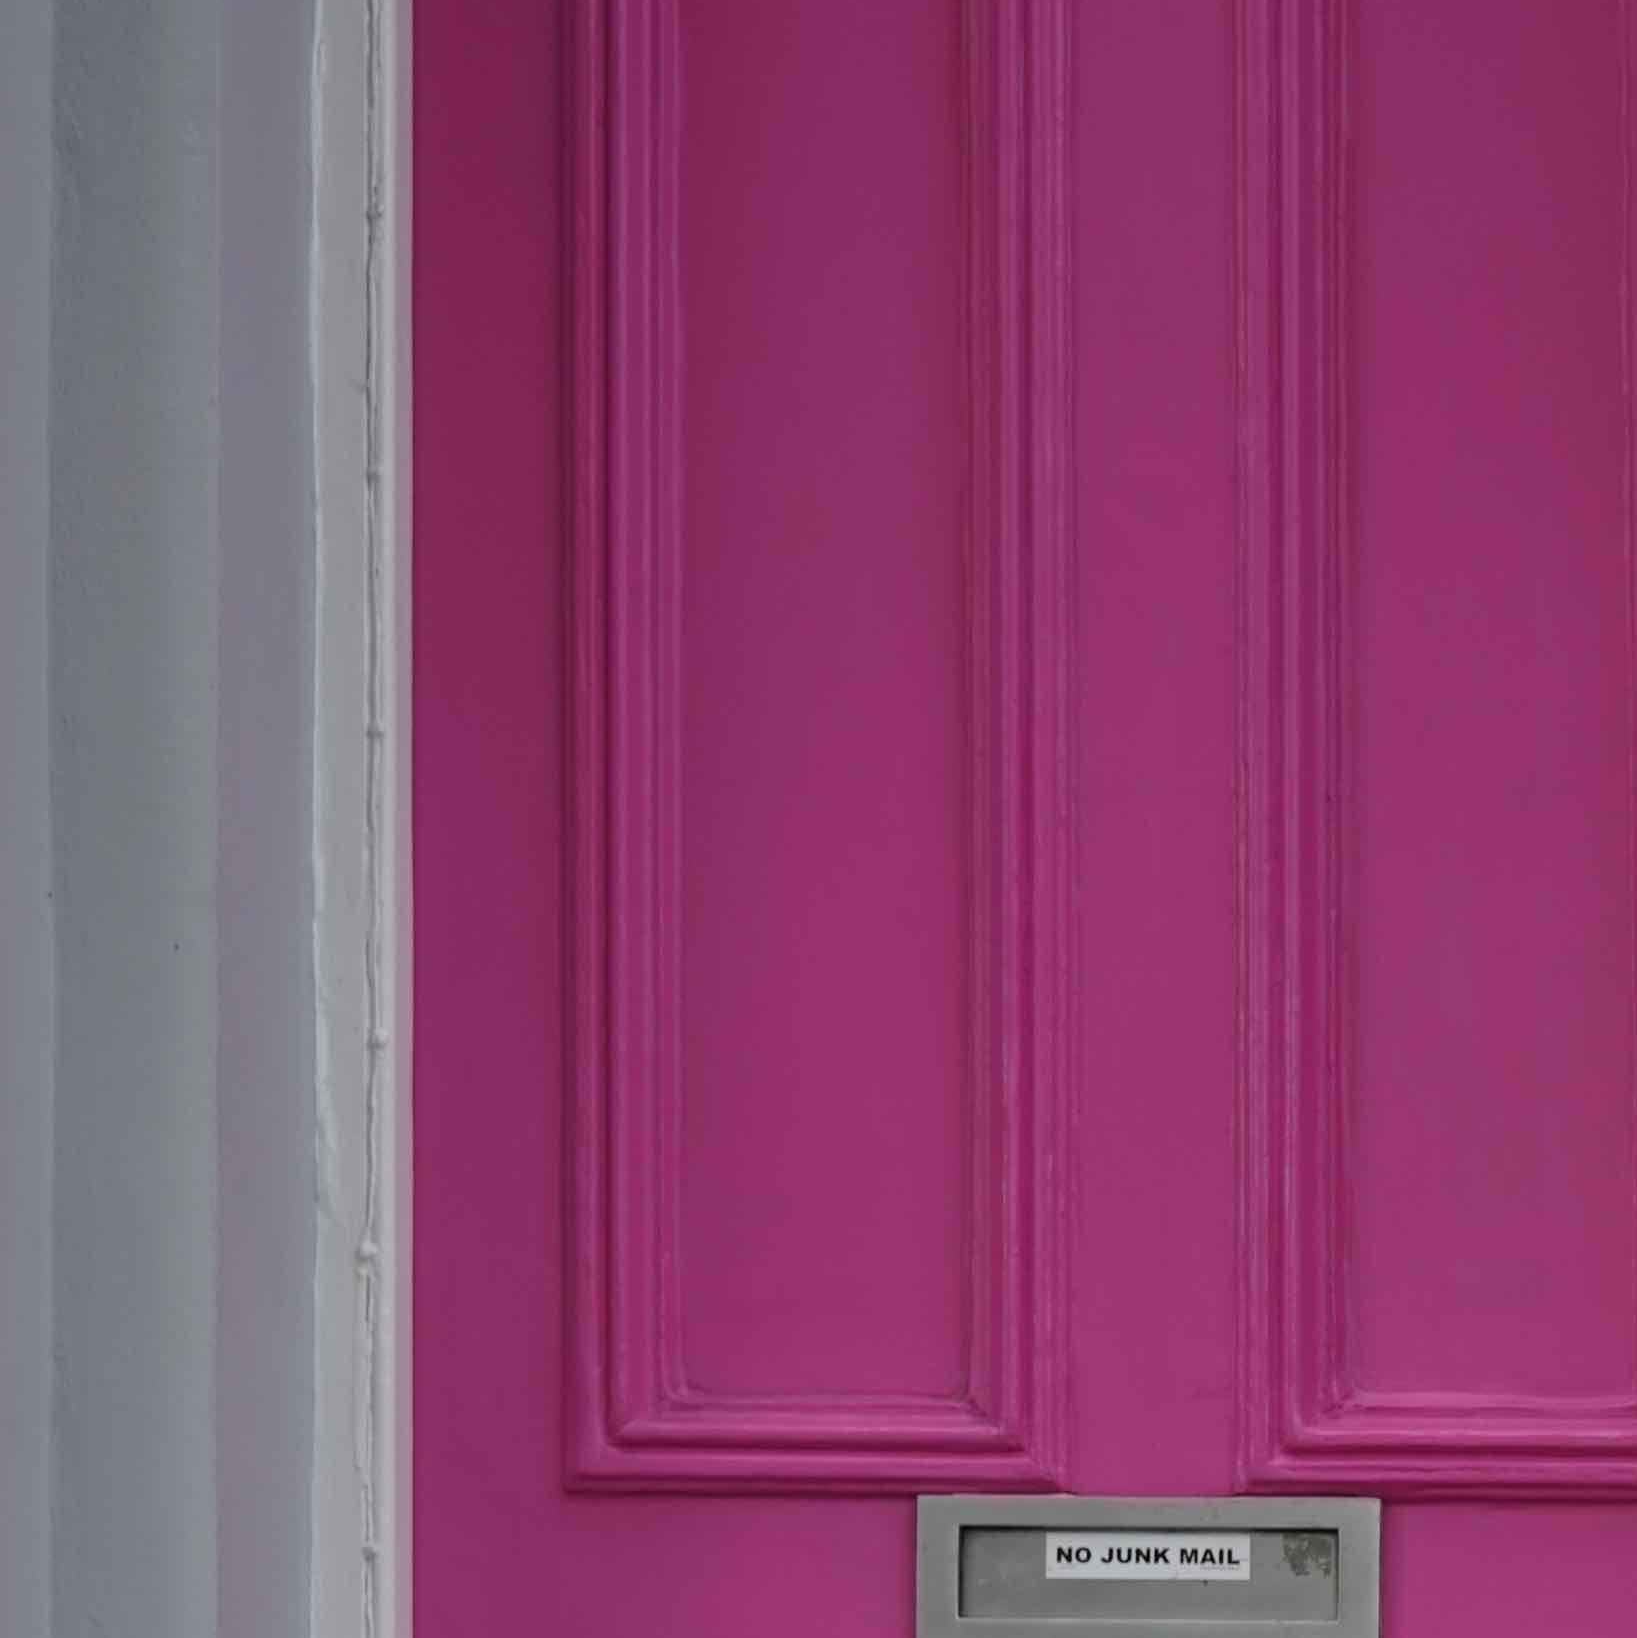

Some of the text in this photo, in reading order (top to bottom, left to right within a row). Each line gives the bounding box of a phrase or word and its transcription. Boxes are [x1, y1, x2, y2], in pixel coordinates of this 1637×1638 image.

[1056, 1546, 1241, 1565] NO JUNK MAIL
